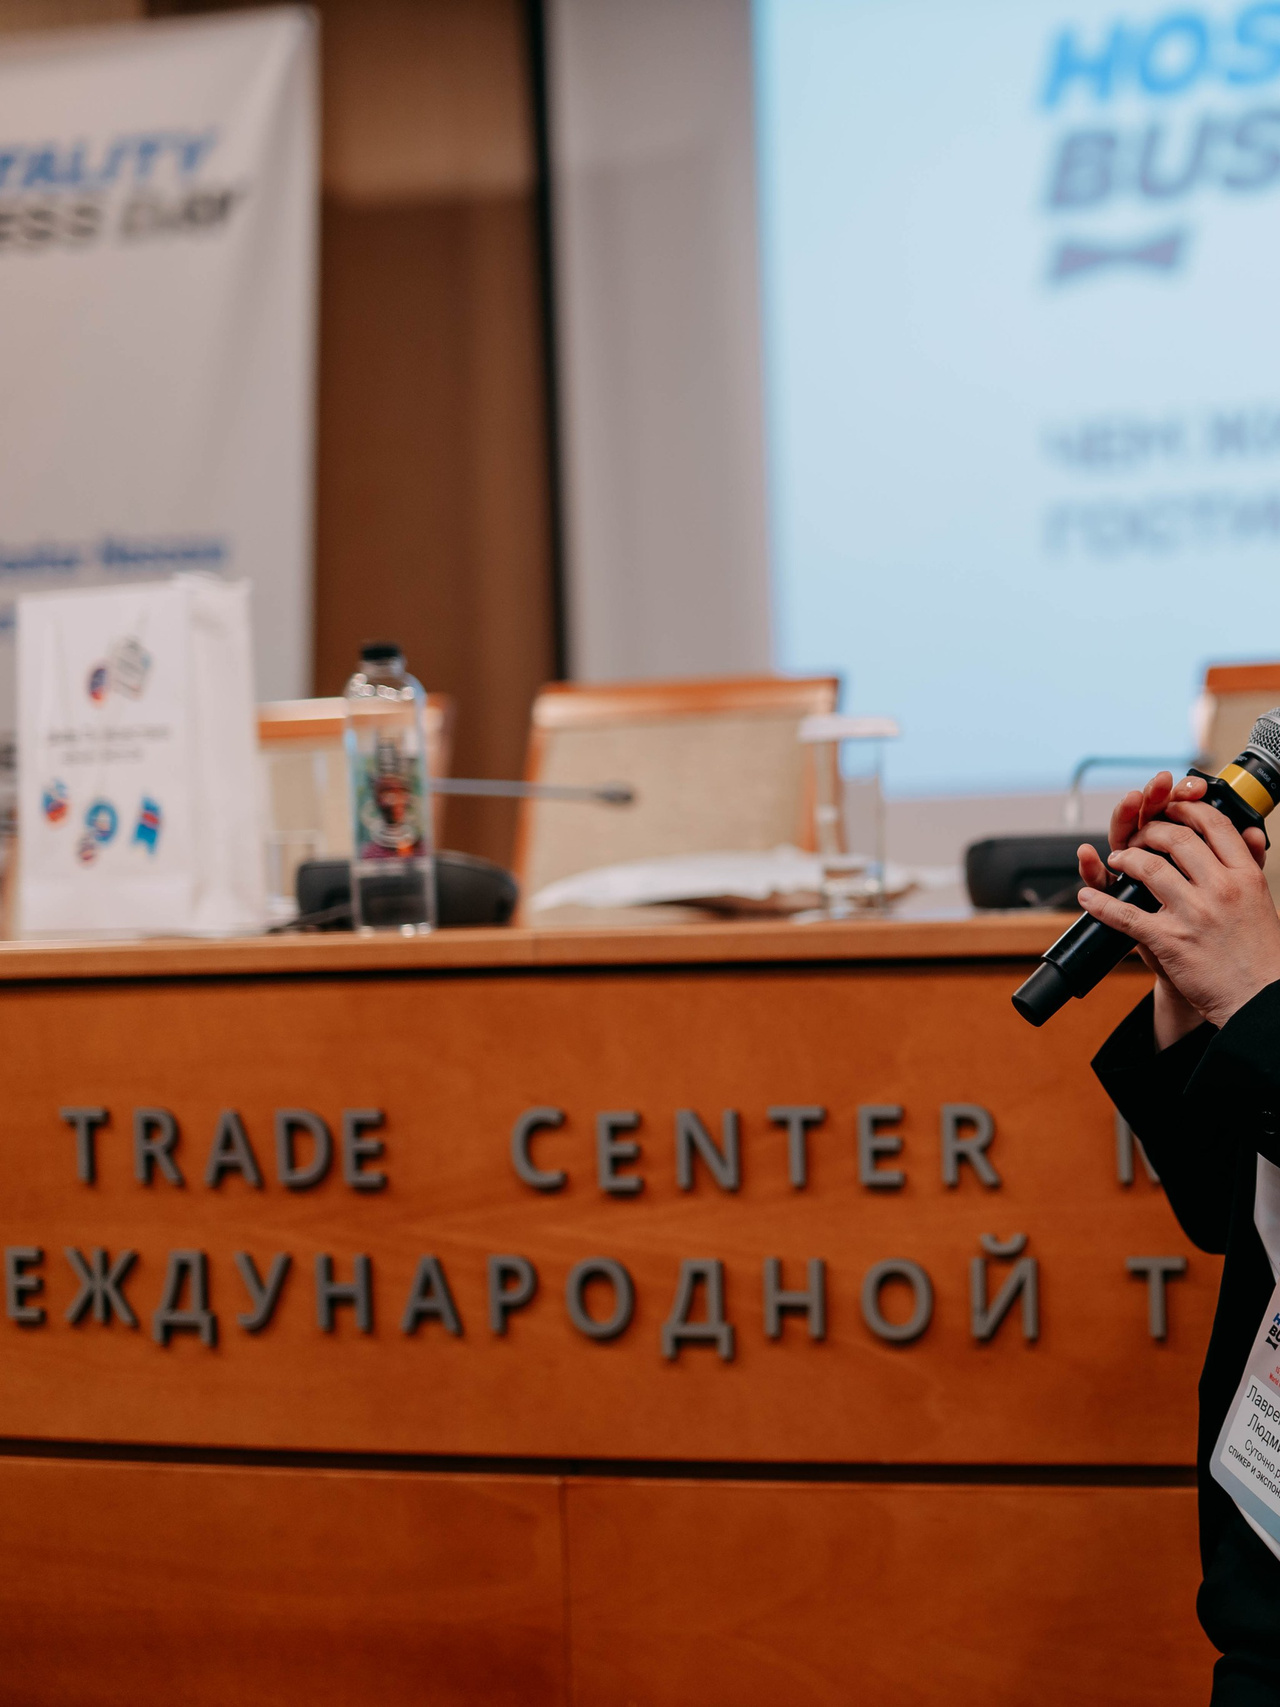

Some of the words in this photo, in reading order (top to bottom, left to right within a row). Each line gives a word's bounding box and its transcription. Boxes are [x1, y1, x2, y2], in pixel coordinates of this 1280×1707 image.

[60, 1106, 389, 1188] TRADE
[511, 1103, 1001, 1192] CENTER
[4, 1233, 1040, 1361] ЕЖДУНАРОДНОЙ
[1269, 1372, 1279, 1386] World
[1228, 1445, 1251, 1468] СПИКЕР
[1250, 1465, 1257, 1475] И
